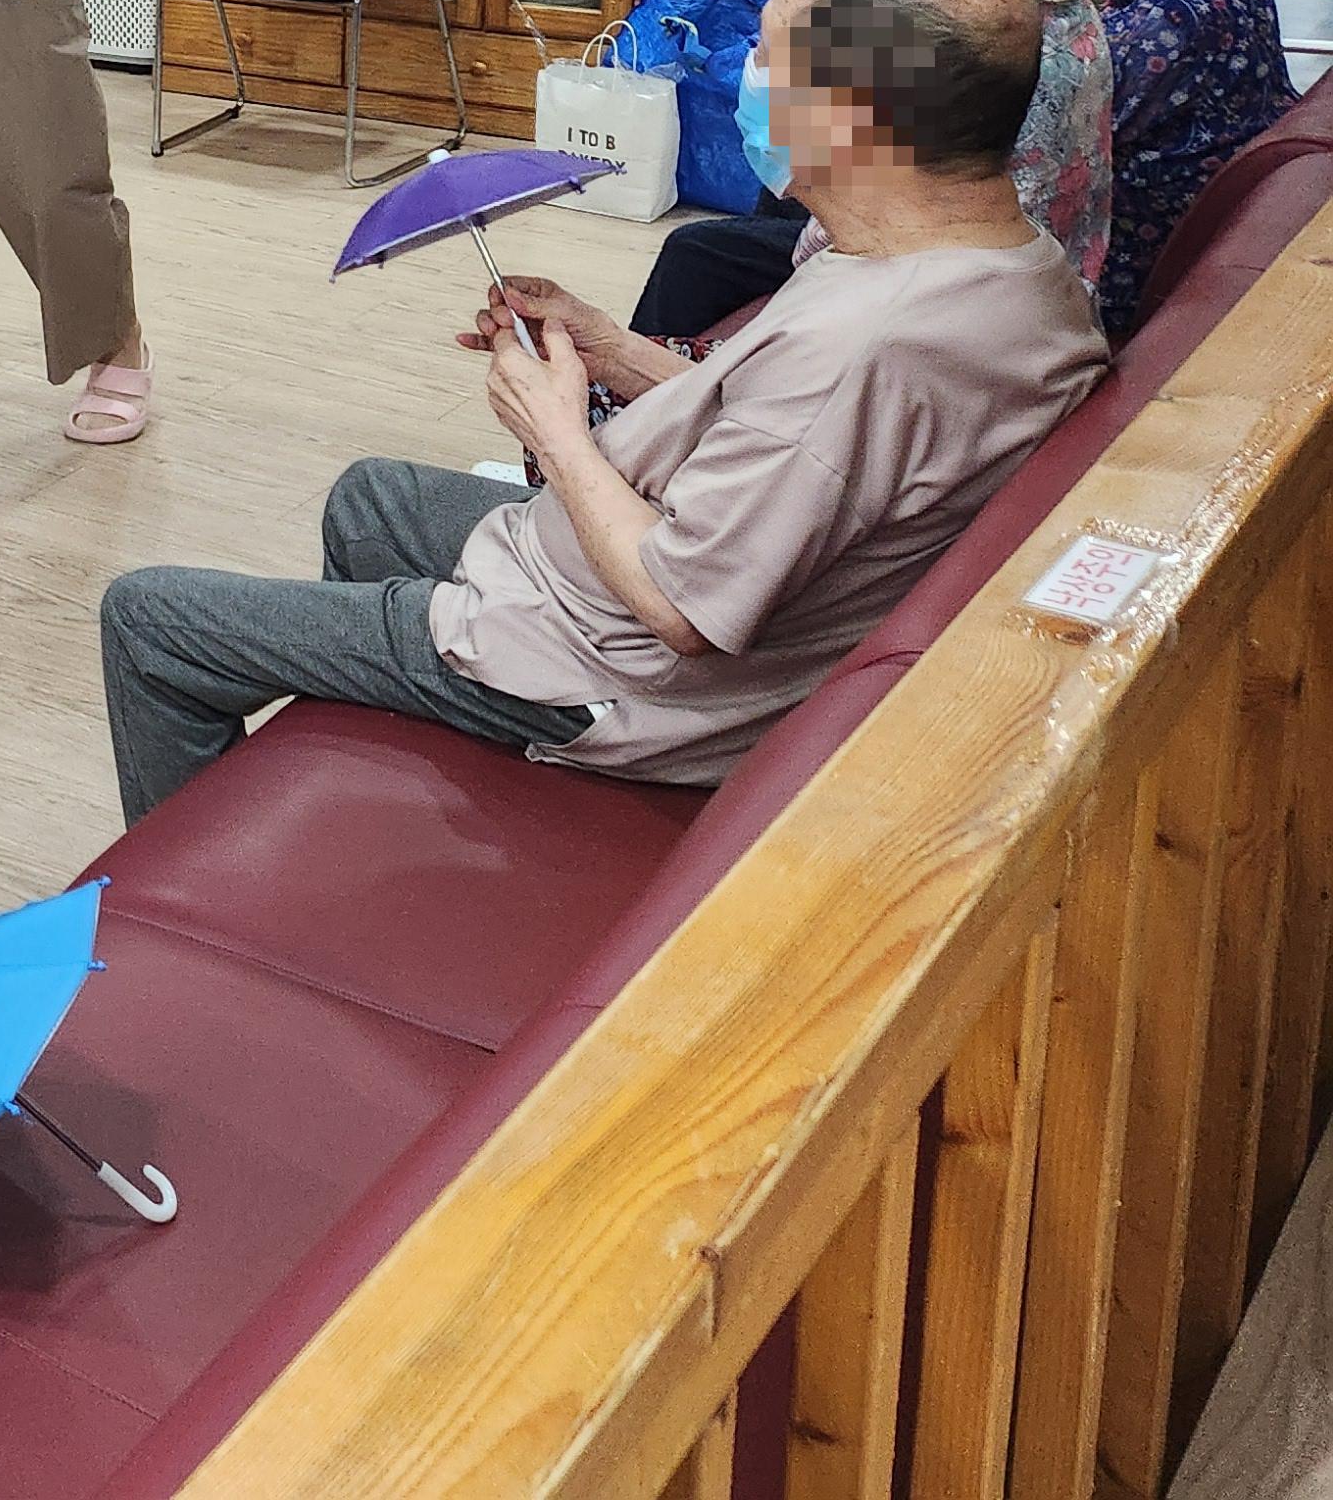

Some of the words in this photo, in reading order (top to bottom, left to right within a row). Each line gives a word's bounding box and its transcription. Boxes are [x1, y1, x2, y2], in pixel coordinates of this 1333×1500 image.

[567, 127, 572, 142] I
[579, 129, 598, 147] TO
[606, 135, 616, 150] B
[1042, 543, 1144, 608] 낙상주의
